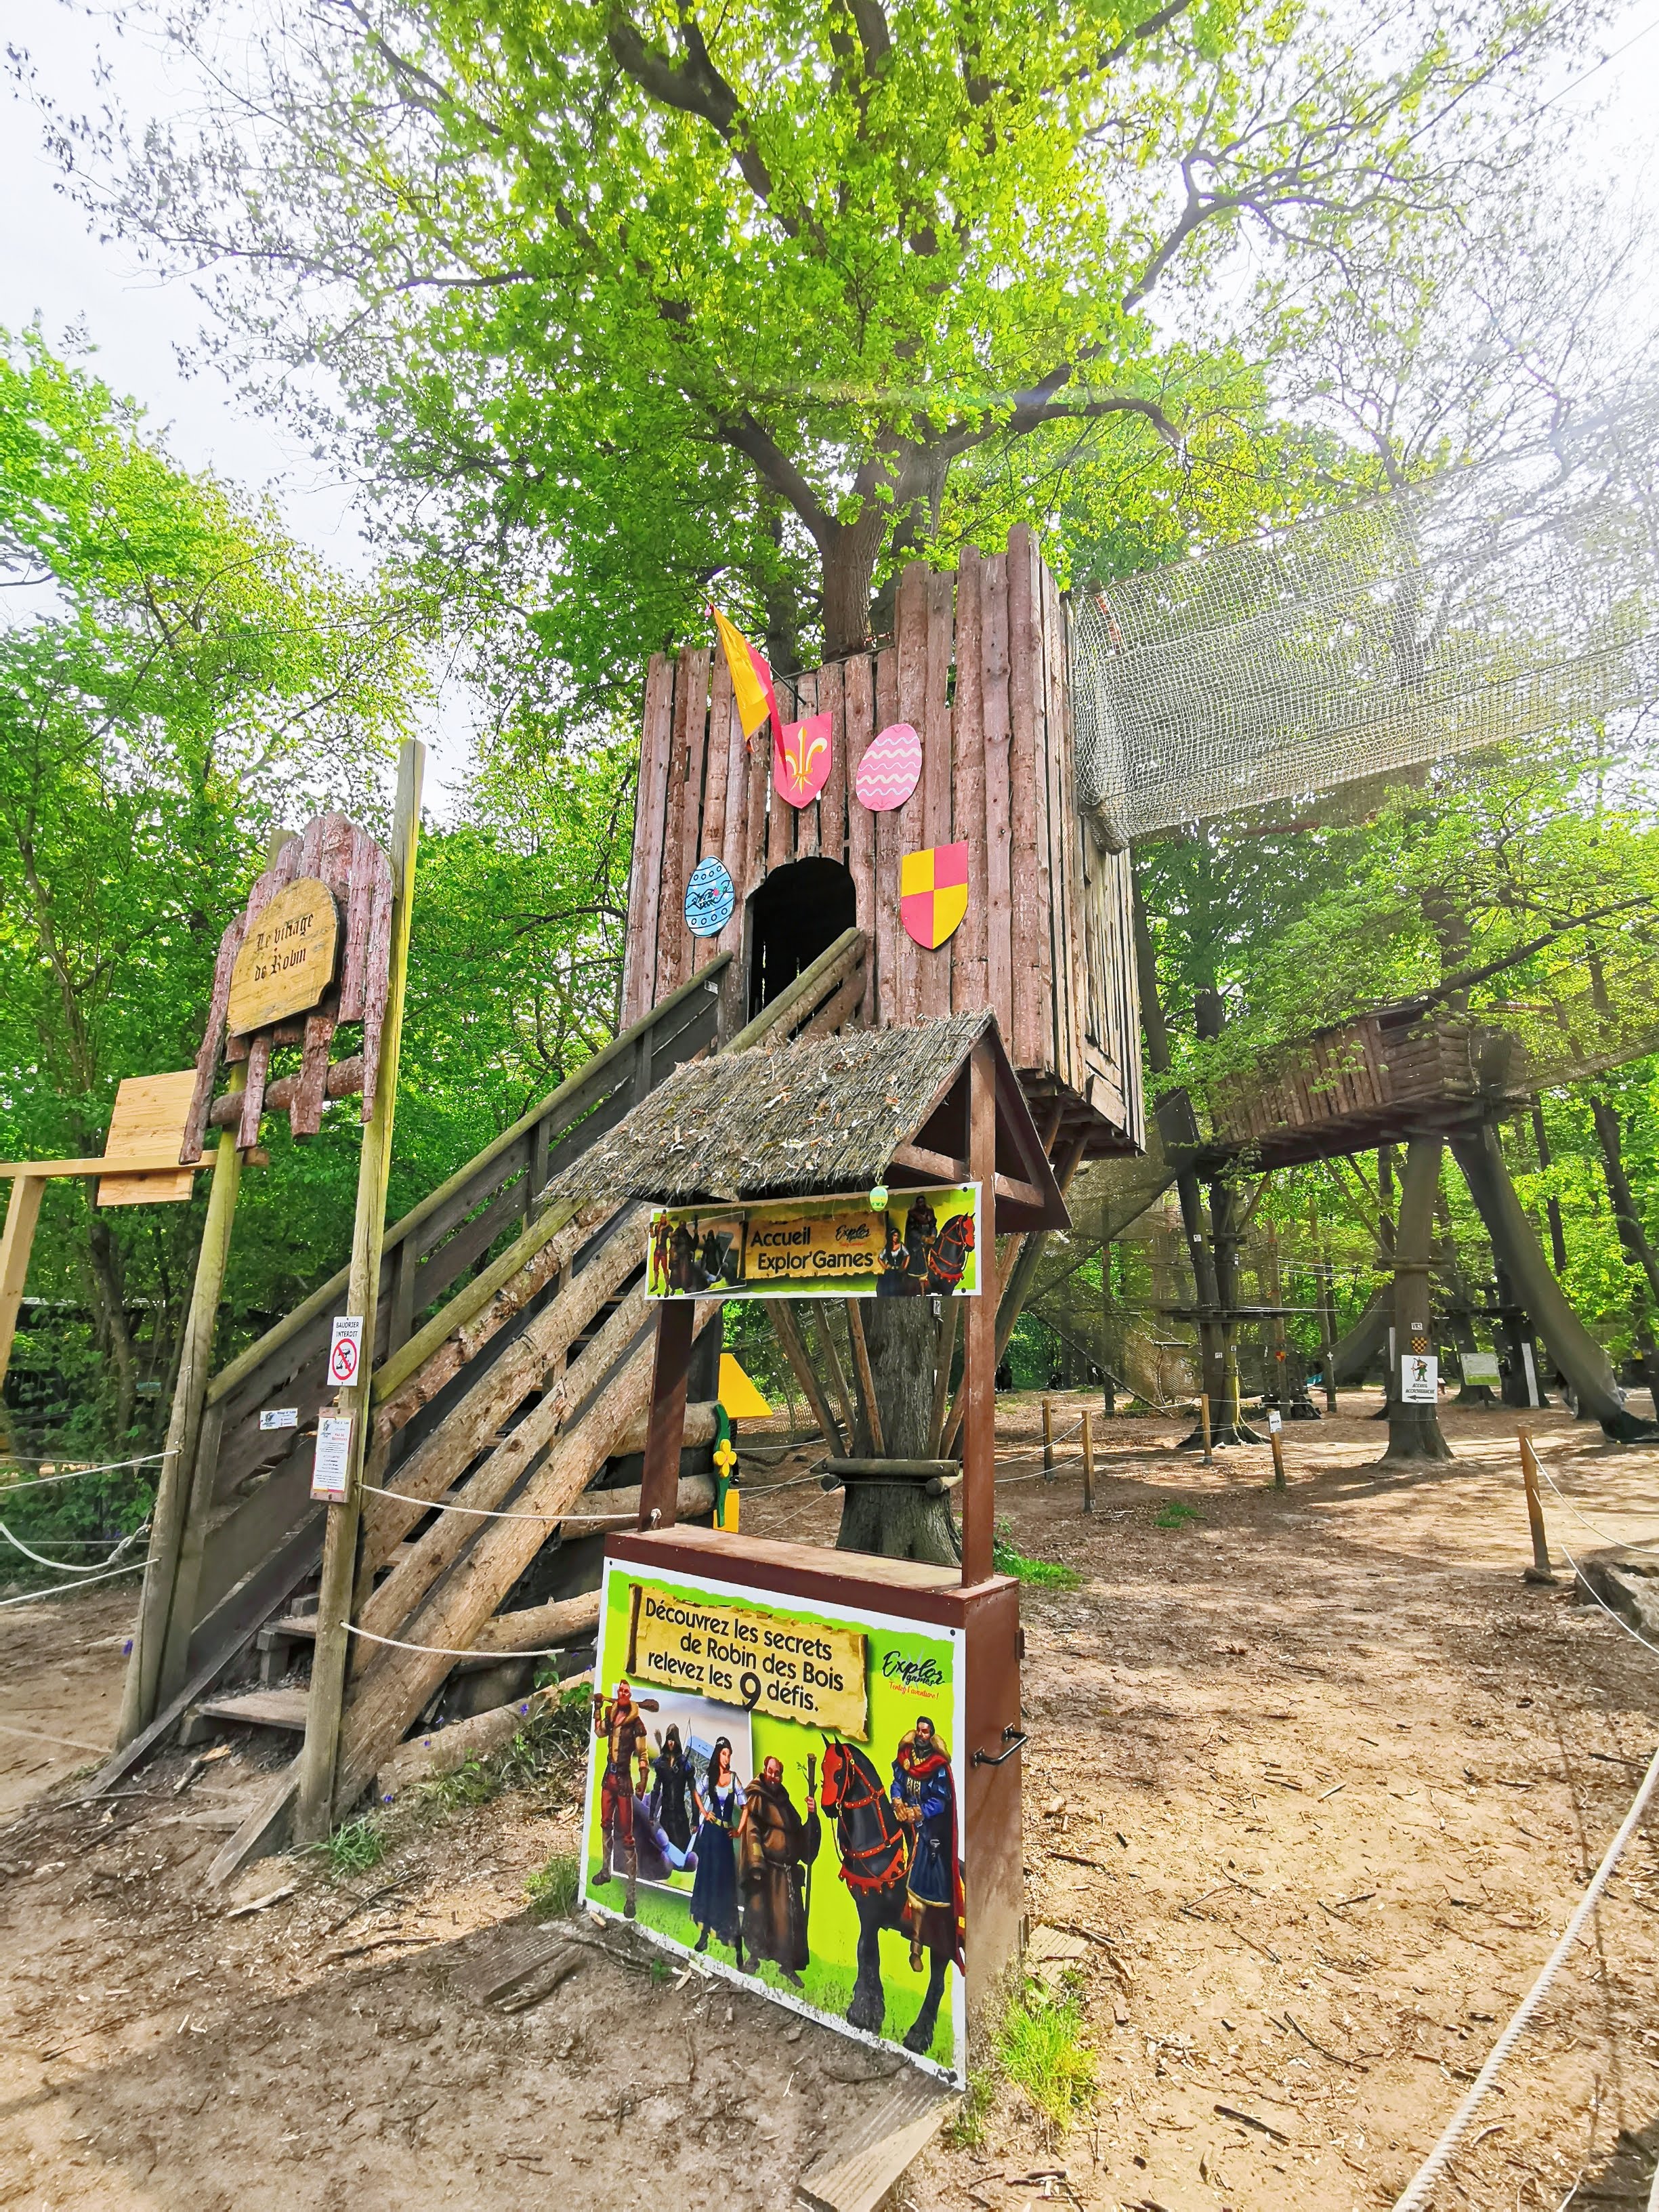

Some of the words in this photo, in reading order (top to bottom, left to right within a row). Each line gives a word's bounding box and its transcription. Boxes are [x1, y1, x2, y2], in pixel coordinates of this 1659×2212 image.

[255, 965, 267, 981] de
[270, 946, 306, 976] Robin
[750, 1226, 811, 1247] Accueil
[646, 1597, 730, 1636] Découvrez
[734, 1618, 759, 1644] les
[763, 1630, 833, 1661] secrets
[648, 1651, 705, 1682] relevez
[709, 1664, 732, 1690] les
[740, 1671, 761, 1713] 9
[767, 1679, 819, 1712] défis.
[680, 1632, 702, 1654] de
[707, 1637, 757, 1669] Robin
[762, 1653, 797, 1679] des
[803, 1661, 843, 1691] Bois
[882, 1650, 945, 1685] Explor
